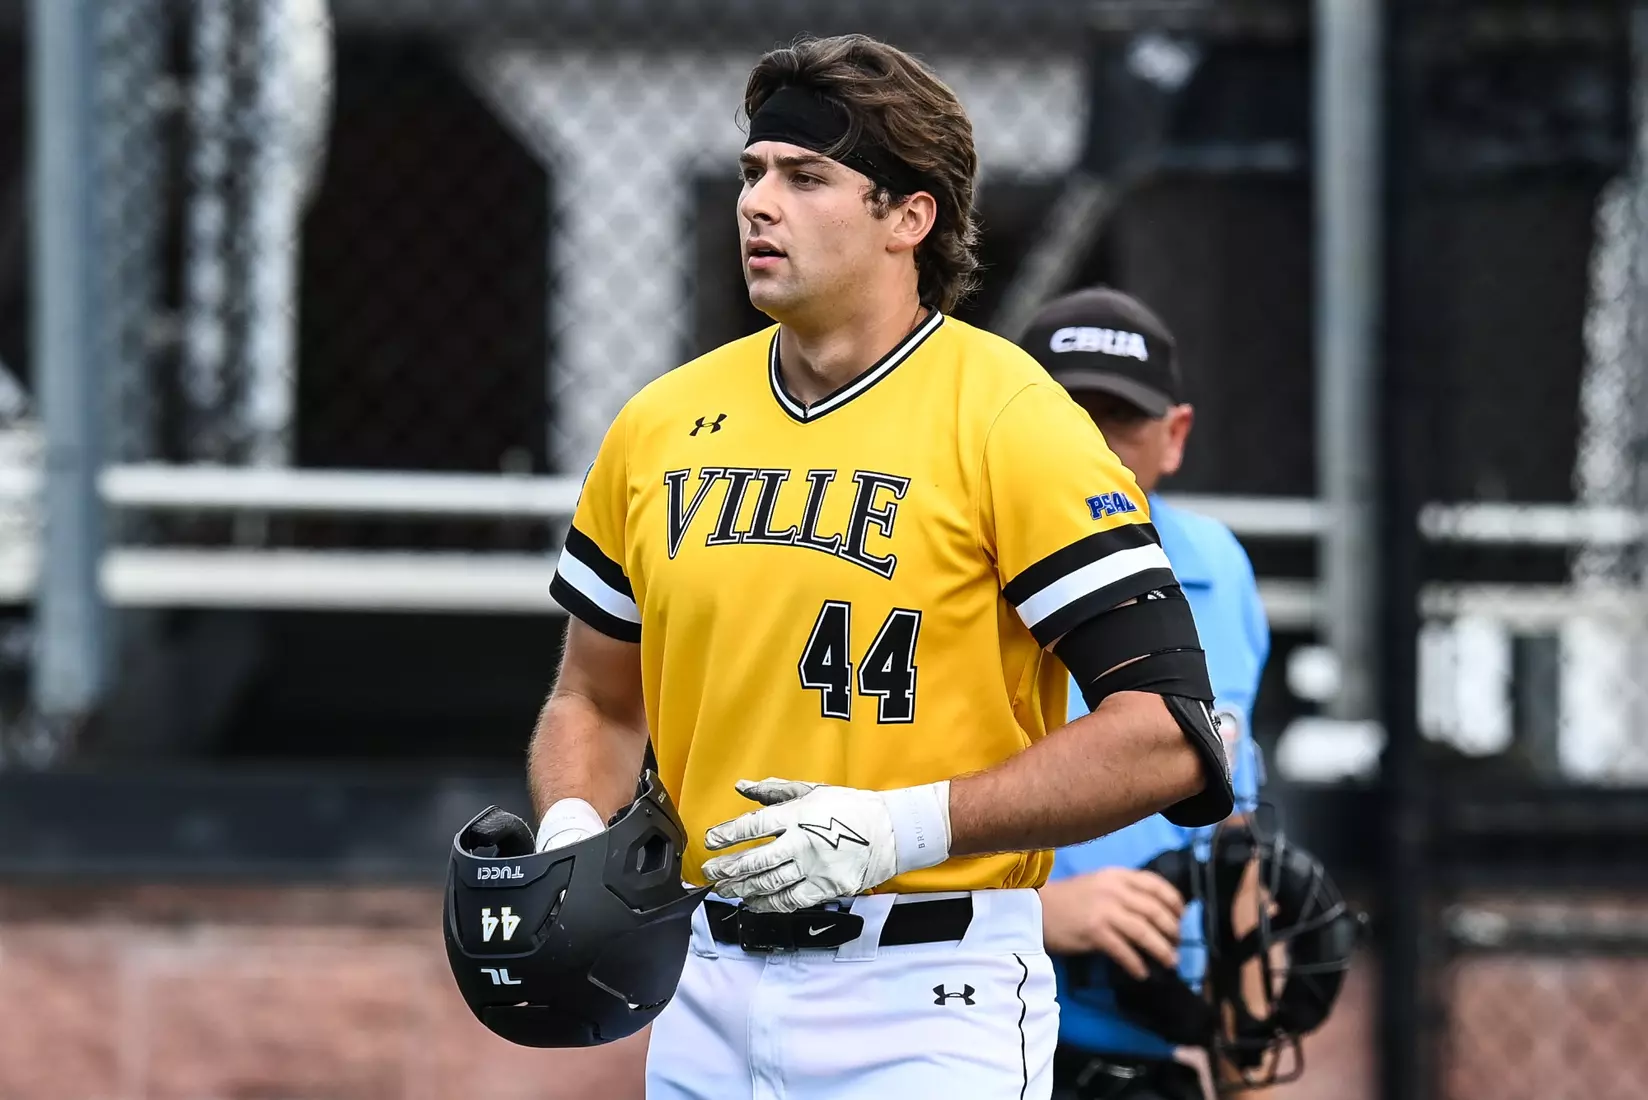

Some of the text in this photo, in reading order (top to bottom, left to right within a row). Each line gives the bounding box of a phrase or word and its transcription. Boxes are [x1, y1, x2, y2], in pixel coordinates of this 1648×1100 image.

[1050, 326, 1148, 361] CBUA
[664, 467, 911, 580] VILLE
[797, 599, 922, 724] 44
[477, 865, 525, 880] TUCCI
[481, 906, 521, 942] 44
